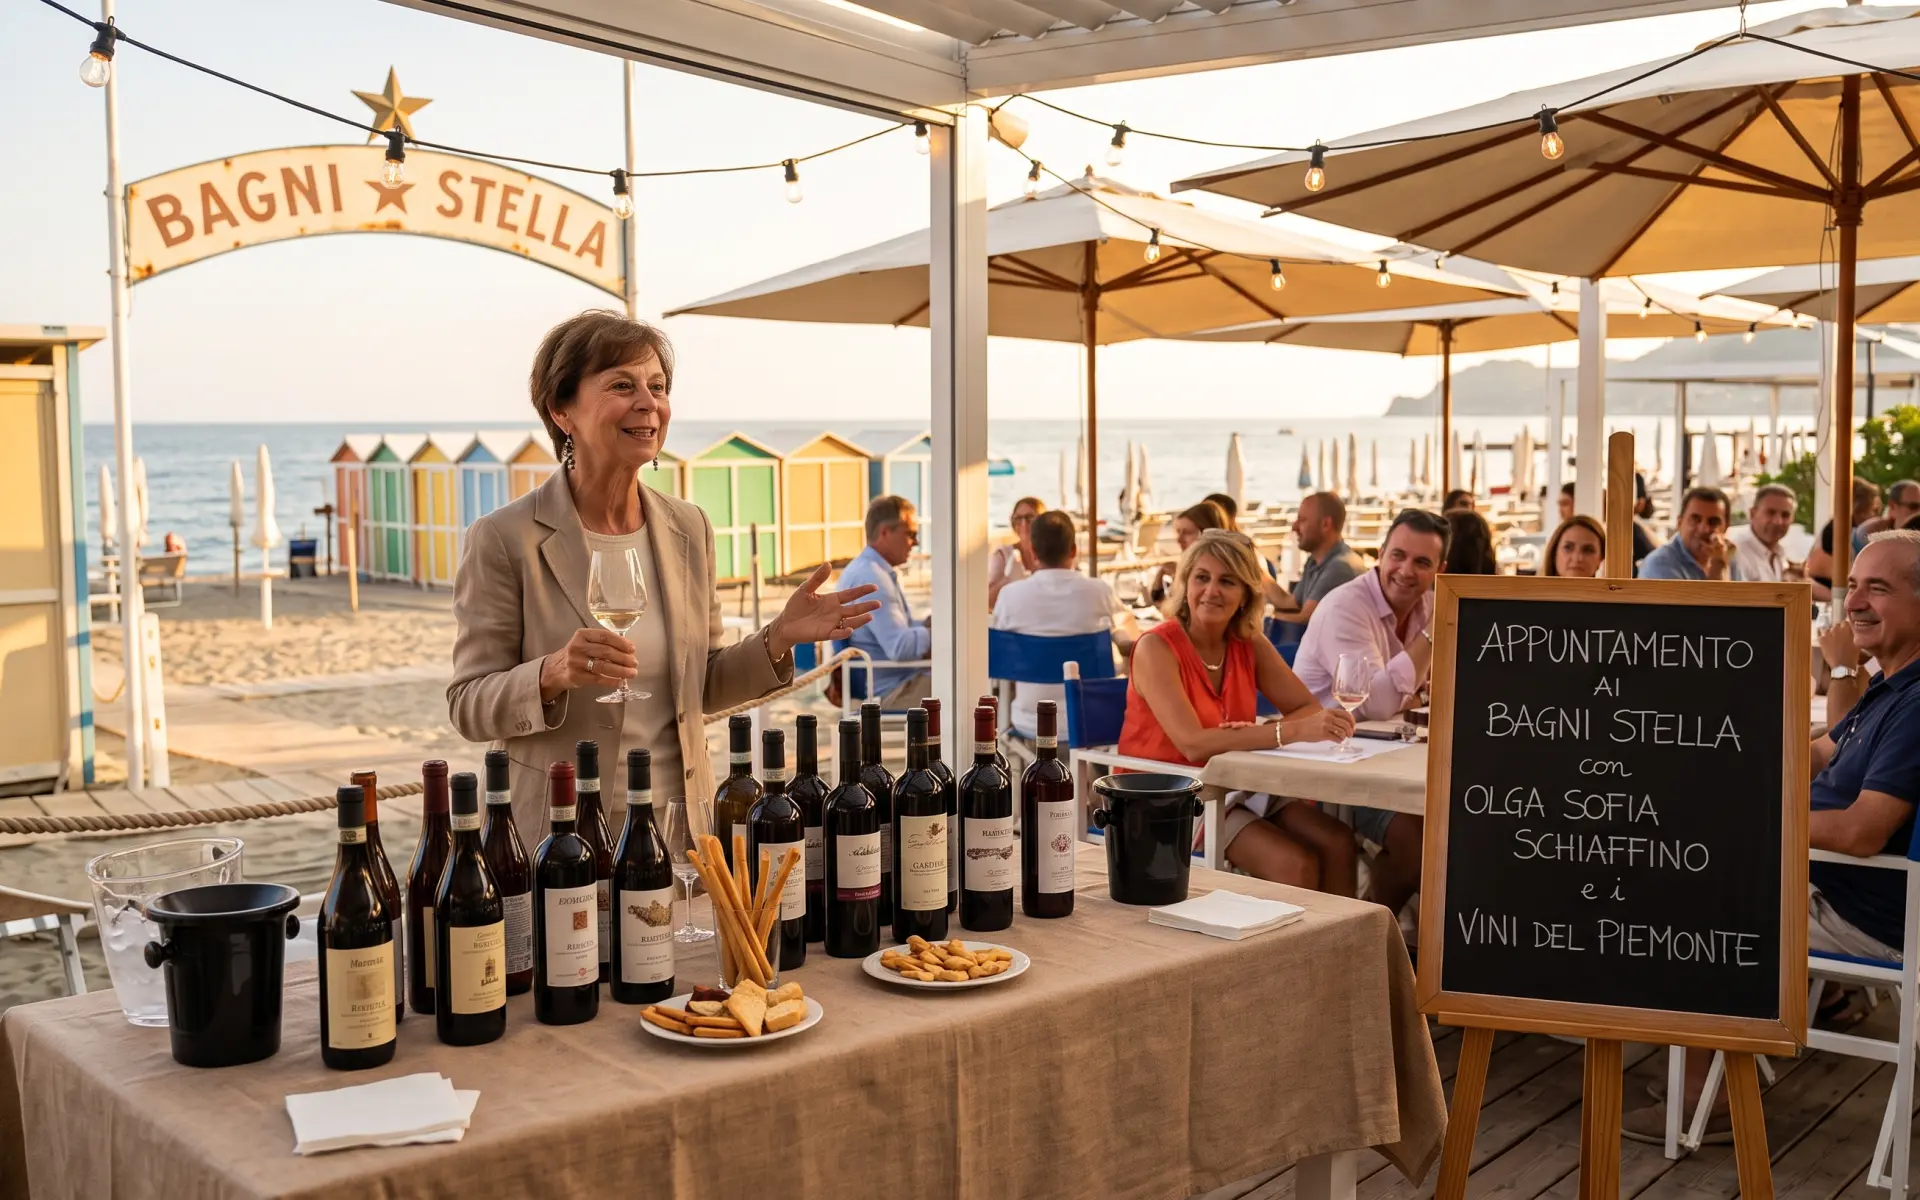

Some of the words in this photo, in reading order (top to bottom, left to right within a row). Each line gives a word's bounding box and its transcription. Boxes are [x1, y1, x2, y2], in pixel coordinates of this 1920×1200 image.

[146, 163, 344, 249] BAGNI
[436, 169, 607, 269] STELLA
[1477, 622, 1753, 669] APPUNTAMENTO
[1594, 676, 1620, 697] AI
[1486, 702, 1590, 741] BAGNI
[1609, 709, 1742, 752] STELLA
[1579, 758, 1632, 778] con
[1464, 785, 1545, 818] OLGA
[1563, 789, 1659, 826] SOFIA
[1513, 829, 1709, 872] SCHIAFFINO
[1581, 883, 1598, 900] e
[1610, 877, 1626, 901] i
[1458, 907, 1517, 947] VINI
[1533, 921, 1585, 951] DEL
[1598, 919, 1760, 967] PIEMONTE
